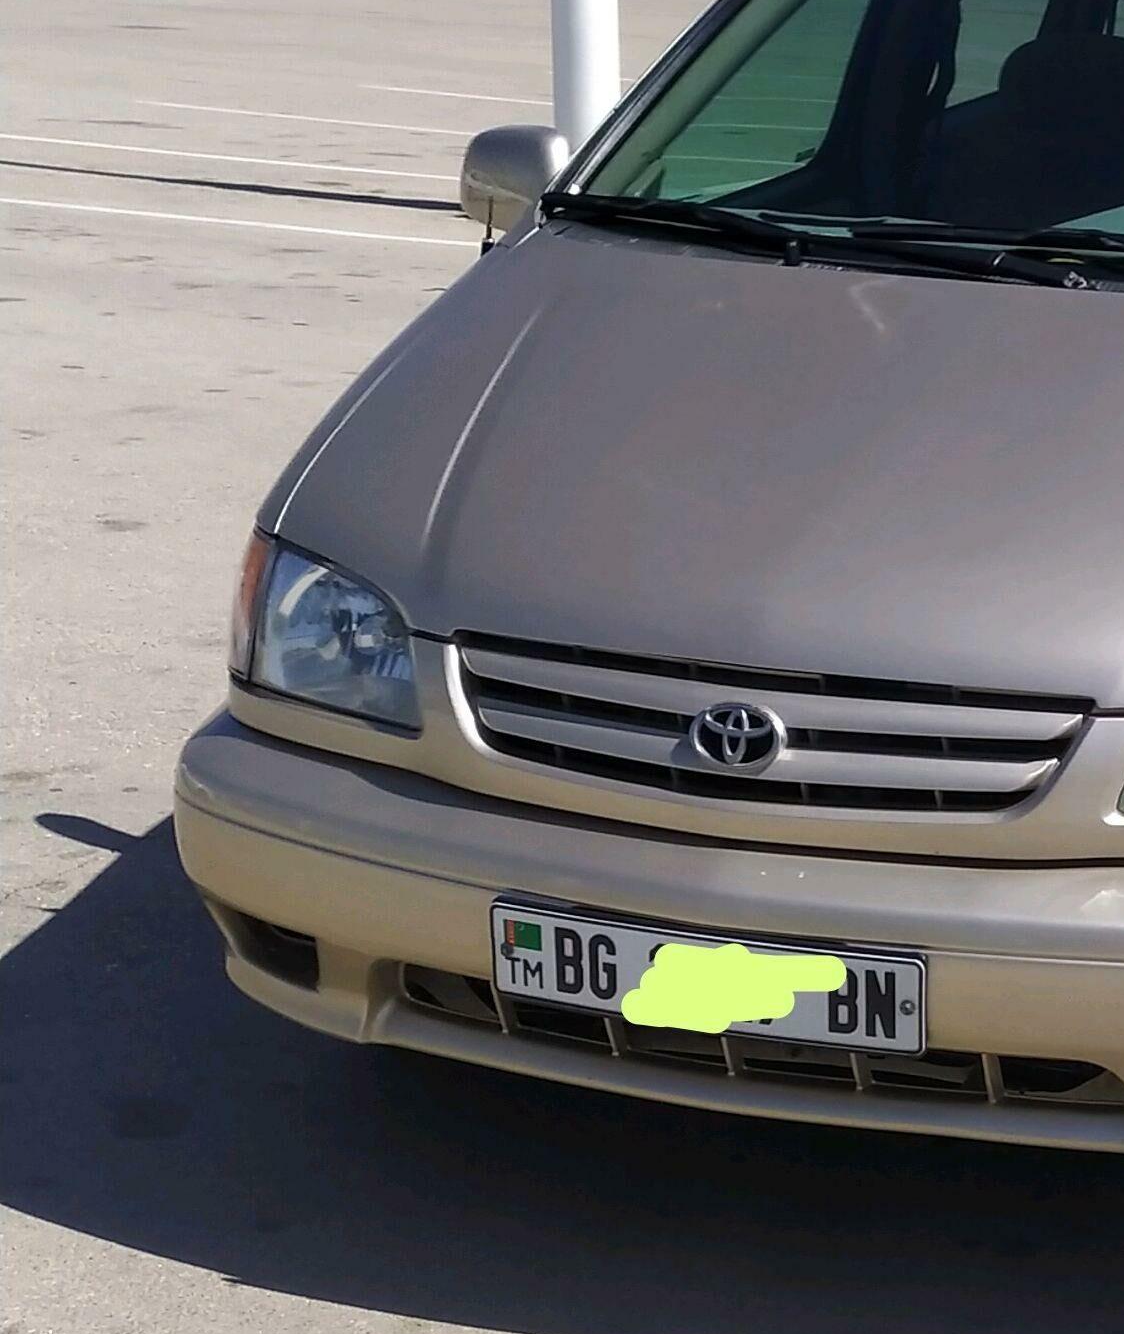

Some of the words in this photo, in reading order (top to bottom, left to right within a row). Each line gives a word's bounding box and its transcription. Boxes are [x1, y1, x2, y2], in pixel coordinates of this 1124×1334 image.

[508, 956, 544, 989] TM
[554, 926, 617, 1001] BG
[827, 968, 897, 1040] BN
